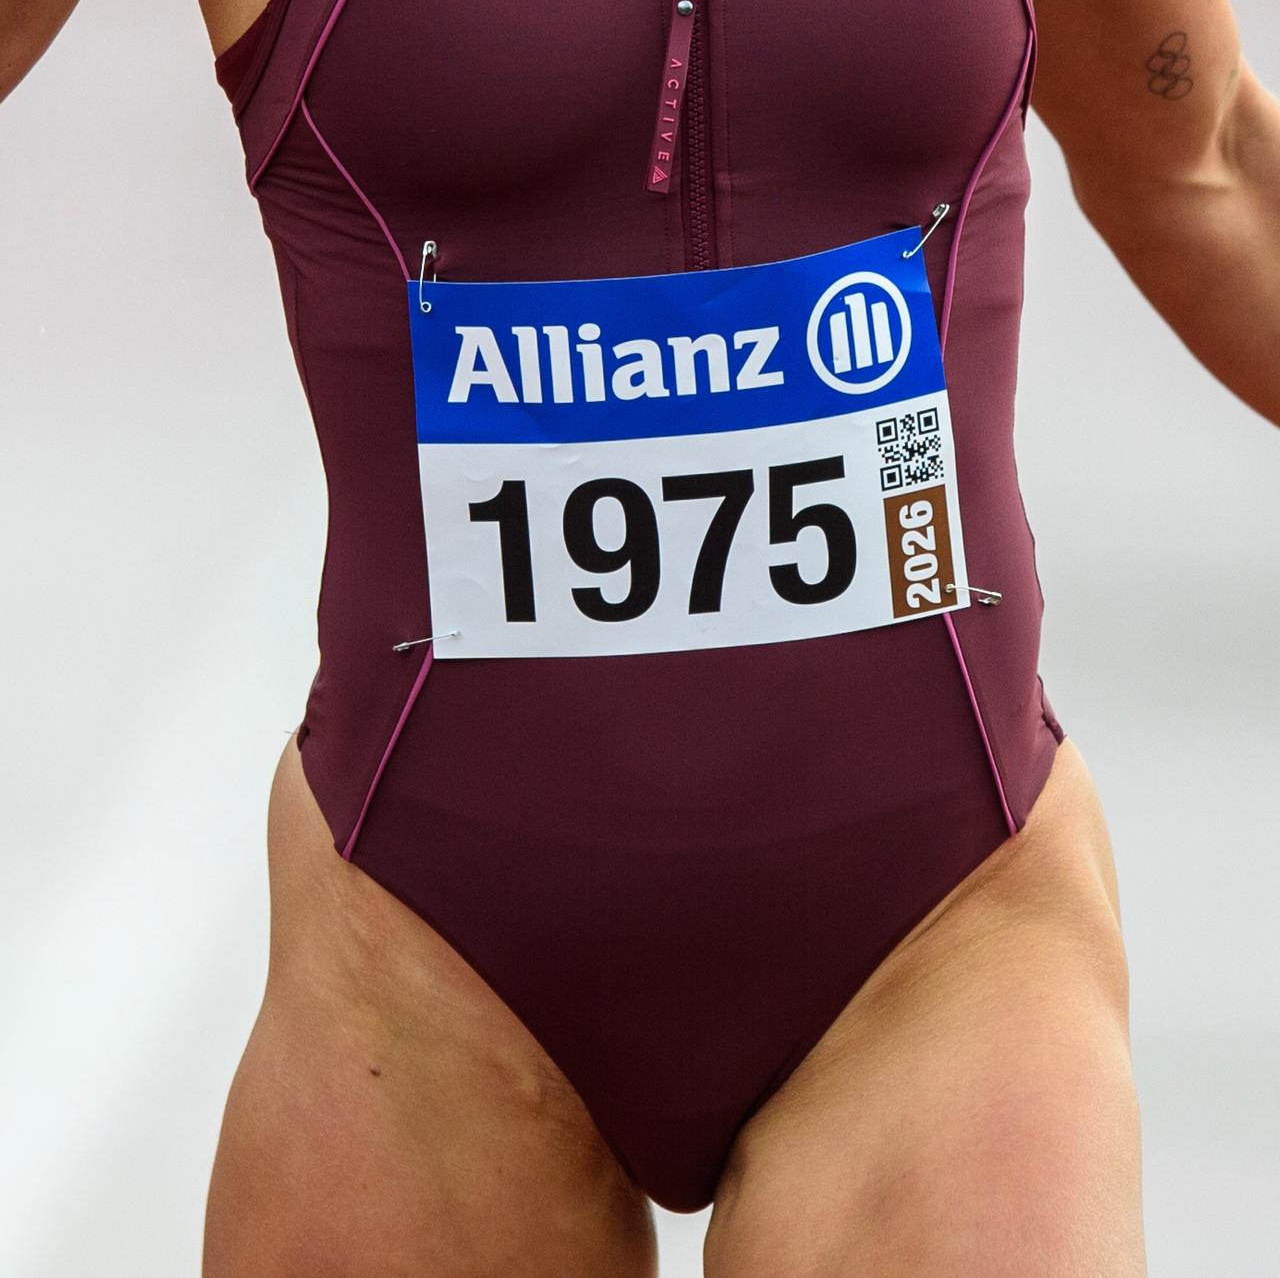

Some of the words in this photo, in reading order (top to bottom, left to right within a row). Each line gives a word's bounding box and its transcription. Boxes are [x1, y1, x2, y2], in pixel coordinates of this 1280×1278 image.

[447, 322, 785, 404] Allianz
[468, 455, 857, 623] 1975
[898, 500, 942, 609] 2026
